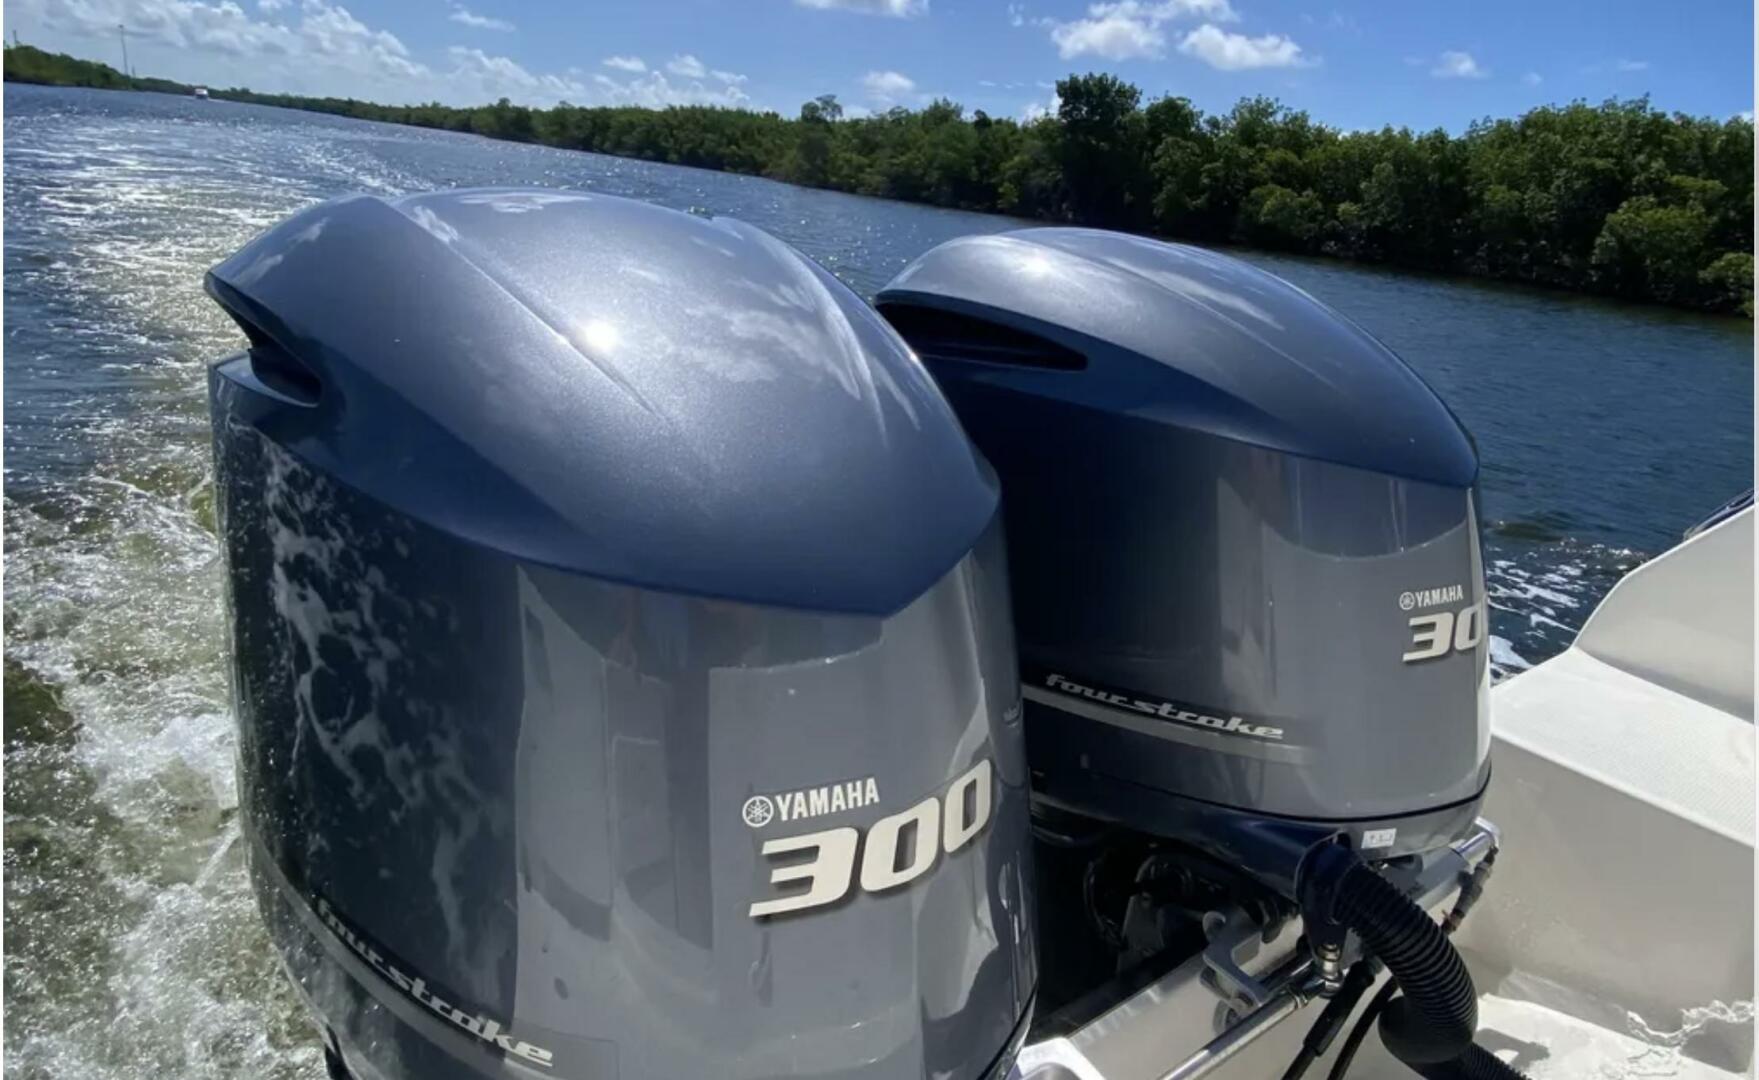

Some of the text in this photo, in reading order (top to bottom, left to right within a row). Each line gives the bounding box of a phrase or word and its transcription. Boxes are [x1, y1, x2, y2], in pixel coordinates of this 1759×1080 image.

[1415, 584, 1464, 608] YAMAHA
[775, 777, 880, 822] YAMAHA
[749, 759, 992, 917] 300
